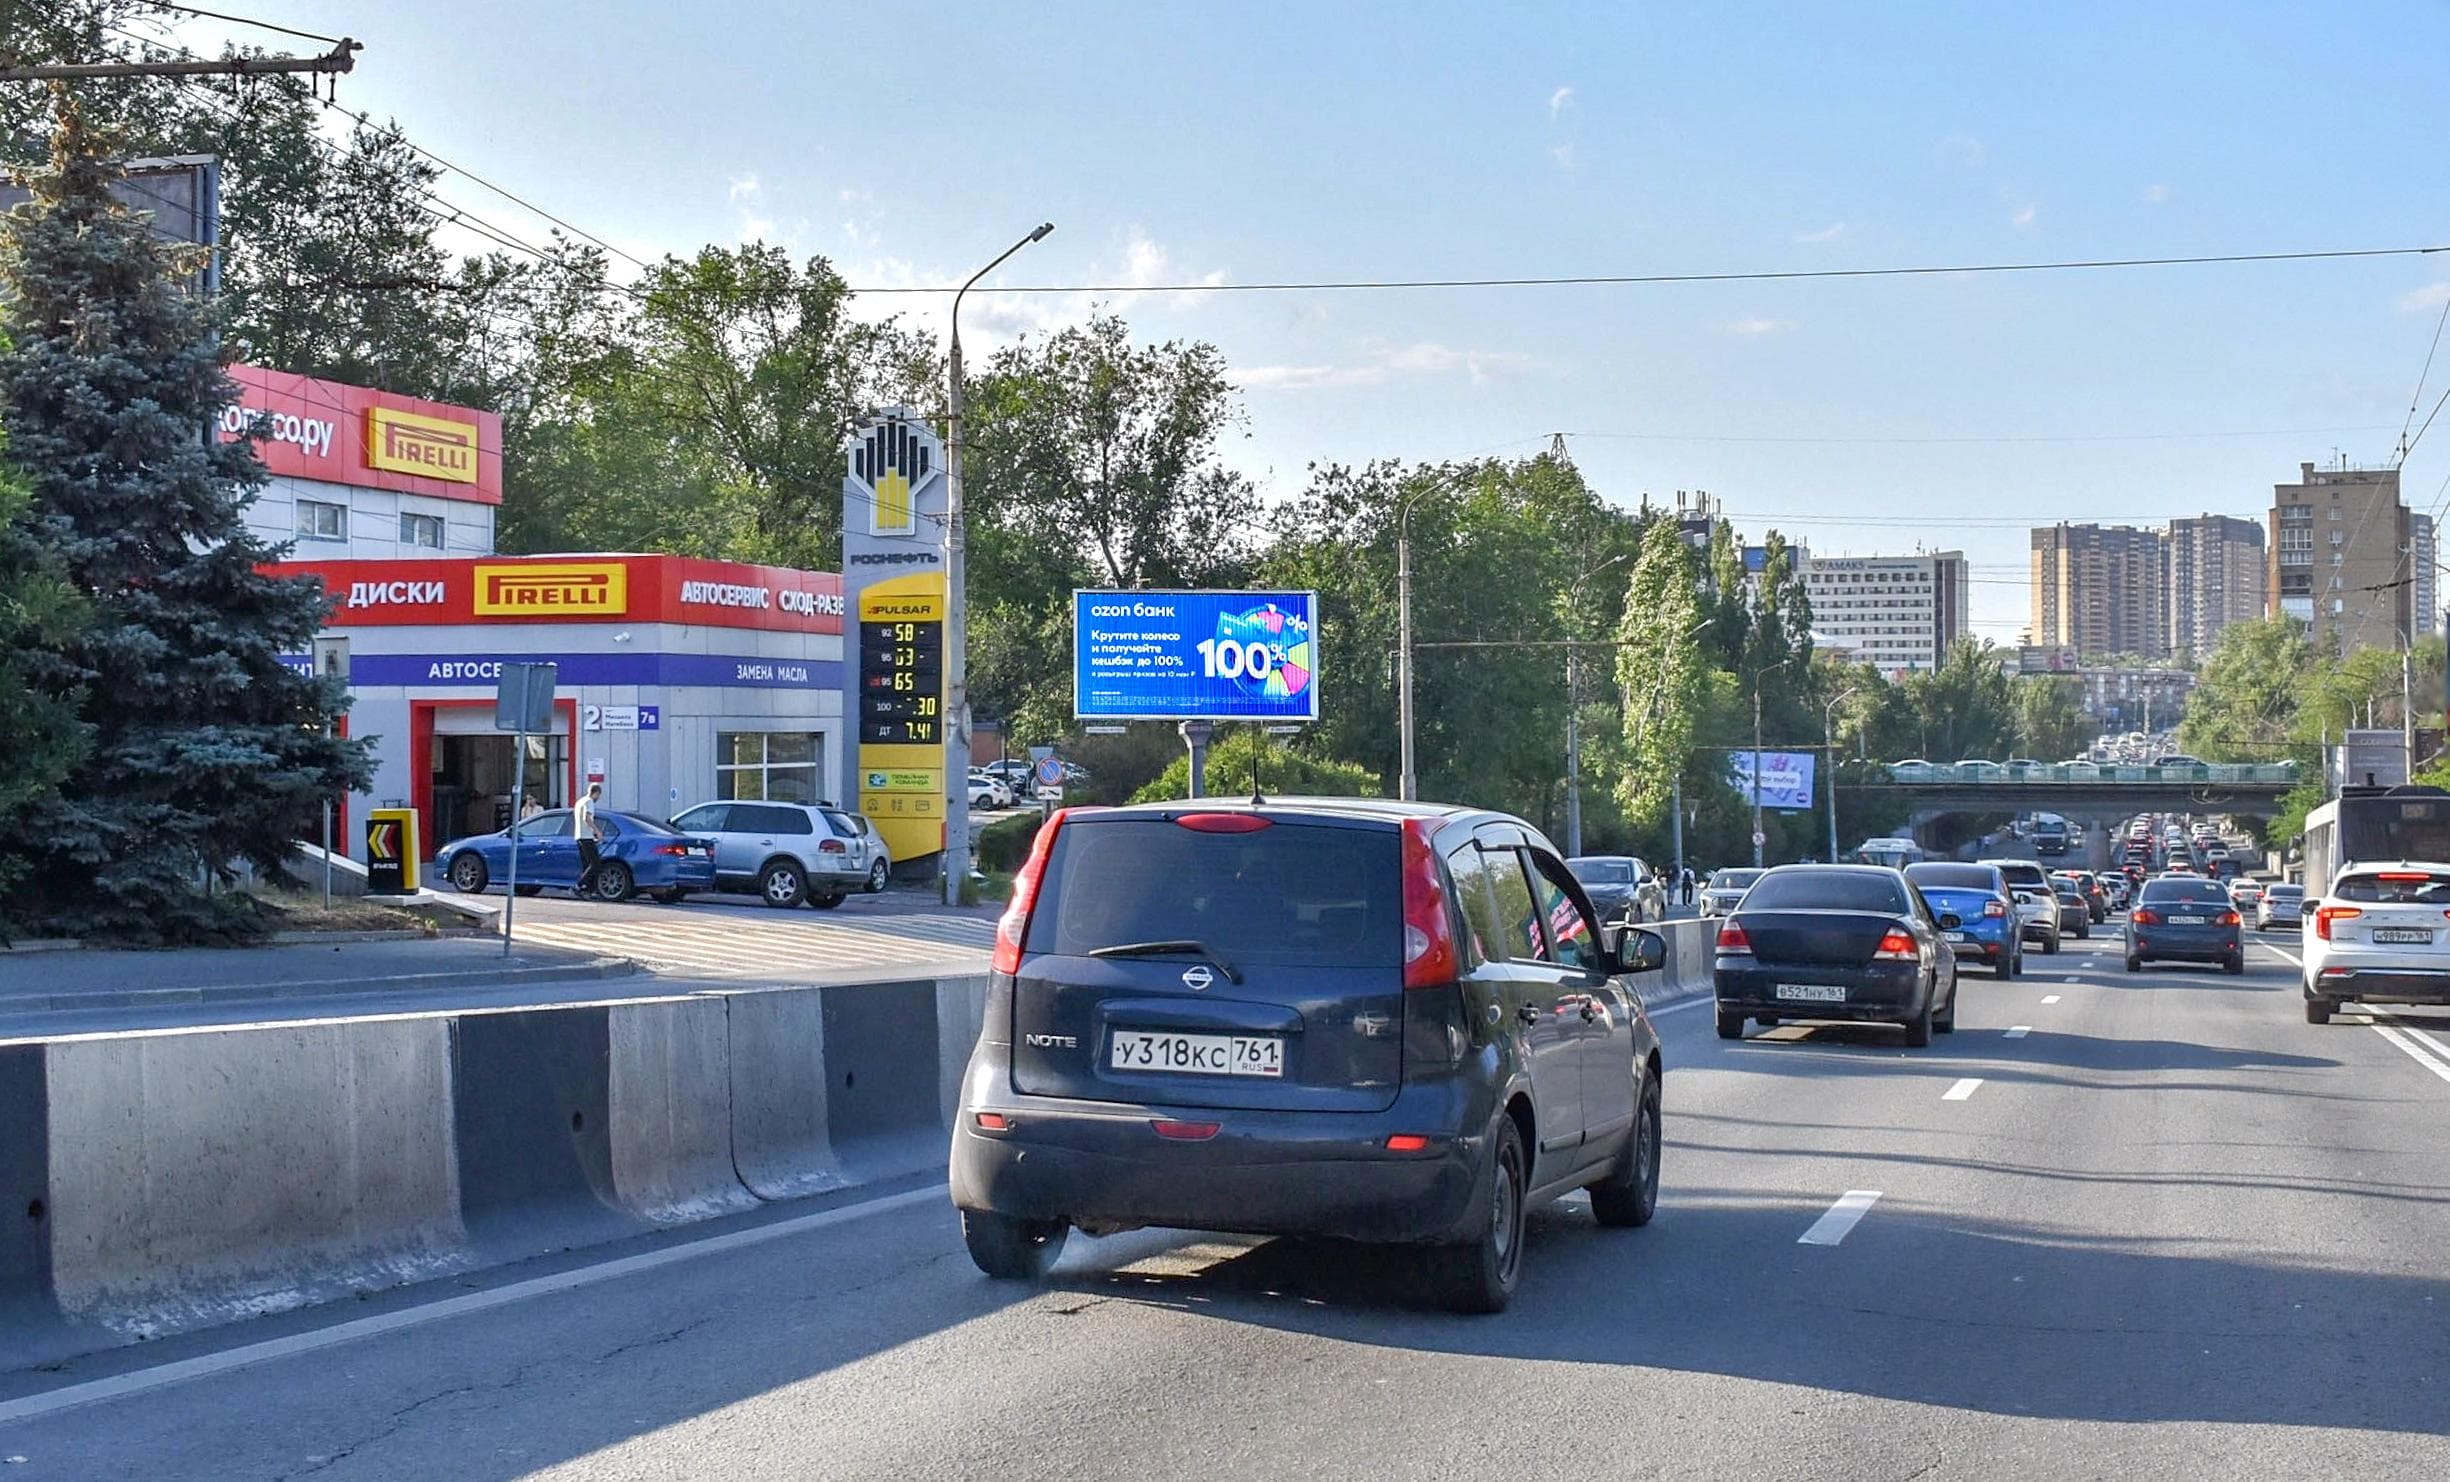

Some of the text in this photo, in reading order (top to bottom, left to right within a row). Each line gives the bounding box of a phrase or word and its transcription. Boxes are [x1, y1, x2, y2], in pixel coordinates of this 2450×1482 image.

[385, 421, 468, 470] PIRELLI
[850, 552, 939, 566] РОСНЕФТЬ
[348, 581, 445, 608] ДИСКИ
[487, 573, 609, 605] PIRELLI
[680, 580, 770, 609] АВТОСЕРВИС
[878, 605, 931, 615] PULSAR
[1091, 602, 1175, 617] ozon банк
[881, 628, 893, 638] 92
[1091, 629, 1181, 643] Крутите колесо
[1091, 643, 1162, 655] и получайте
[1136, 658, 1152, 667] до
[1154, 655, 1184, 667] 100%
[1196, 638, 1286, 679] 100%
[736, 664, 808, 682] ЗАМЕНА МАСЛА
[894, 672, 914, 691] 65
[876, 703, 892, 712] 100
[584, 705, 602, 730] 2
[1026, 1033, 1077, 1048] NOTE
[1119, 1037, 1278, 1069] У318КС 761
[1241, 1062, 1262, 1072] RUS
